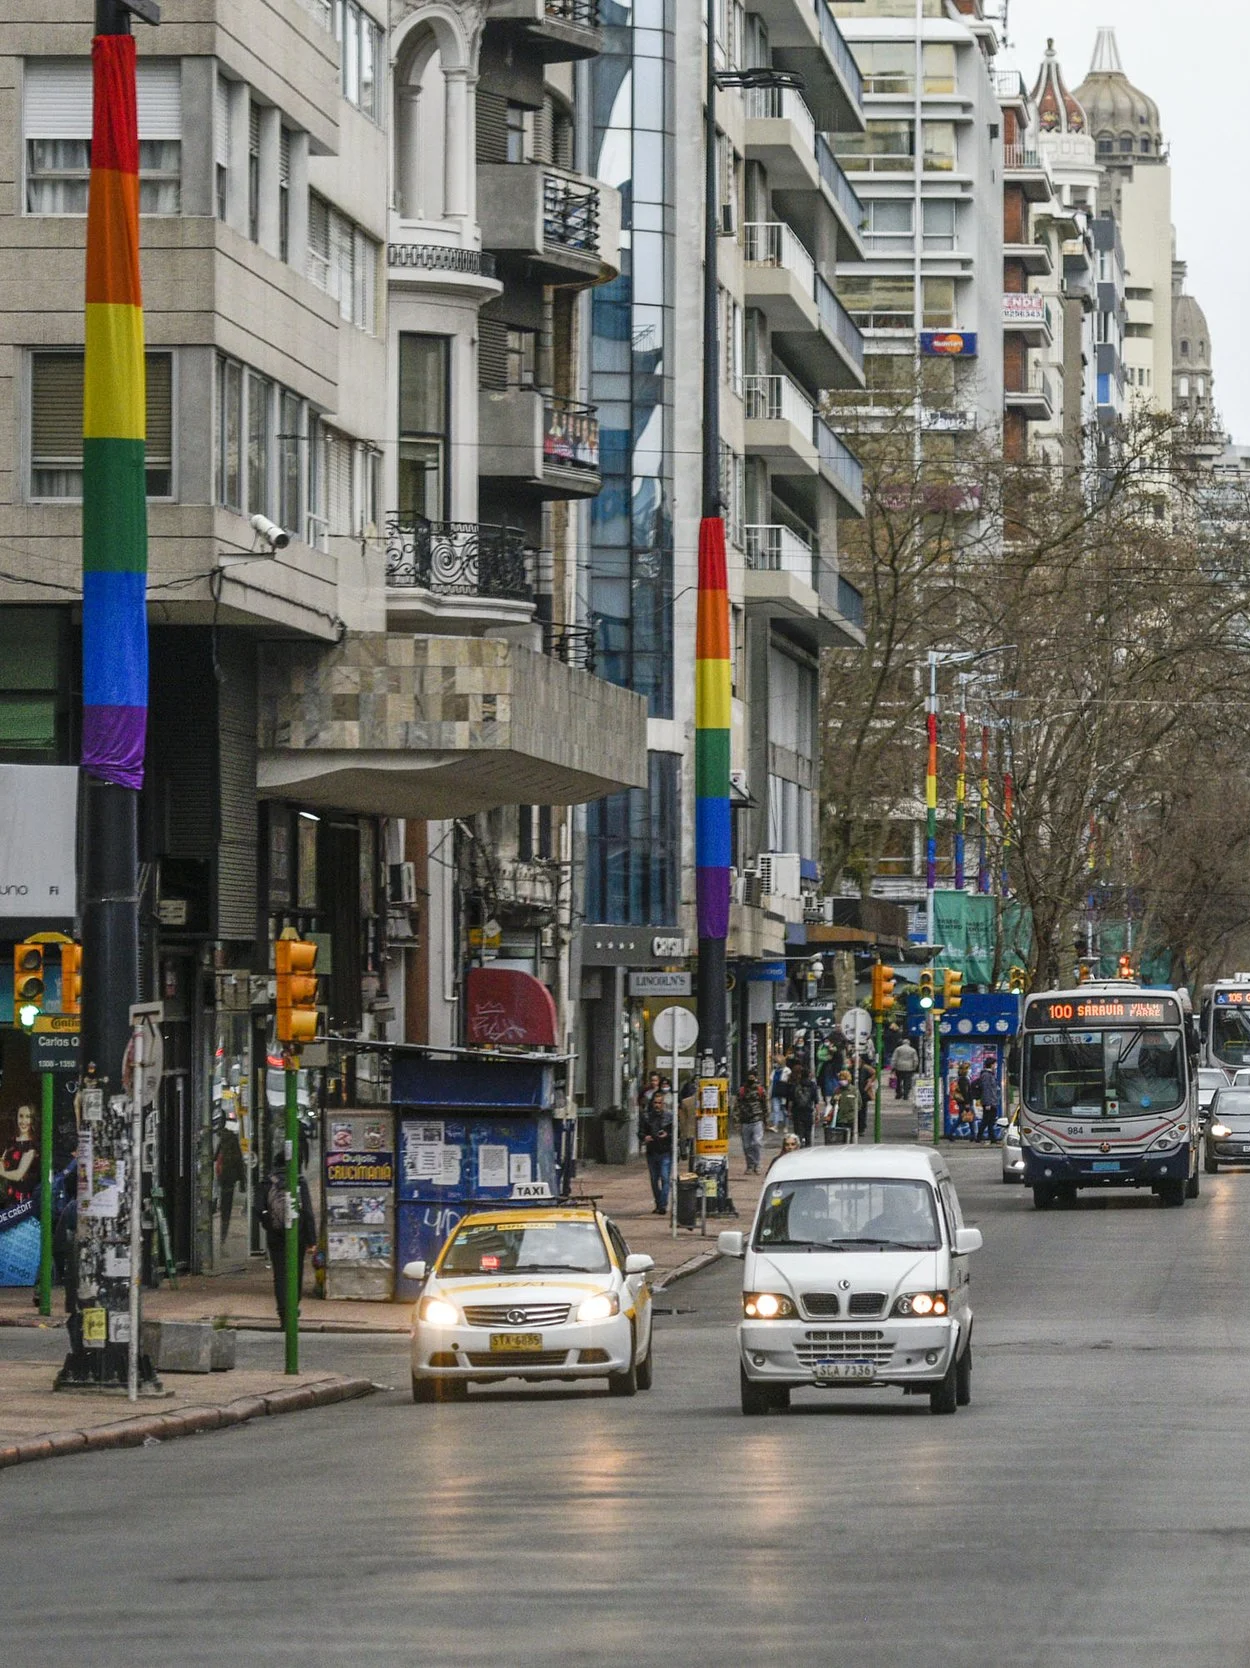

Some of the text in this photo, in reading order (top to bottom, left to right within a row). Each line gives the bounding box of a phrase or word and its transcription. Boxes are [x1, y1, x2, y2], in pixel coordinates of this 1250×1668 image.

[1003, 298, 1042, 308] ENDE
[1228, 992, 1243, 1002] 105
[1050, 1005, 1125, 1019] 100 SARAVIA
[38, 1036, 69, 1047] Carlos
[1067, 1127, 1084, 1135] 984
[516, 1186, 545, 1196] TAXI
